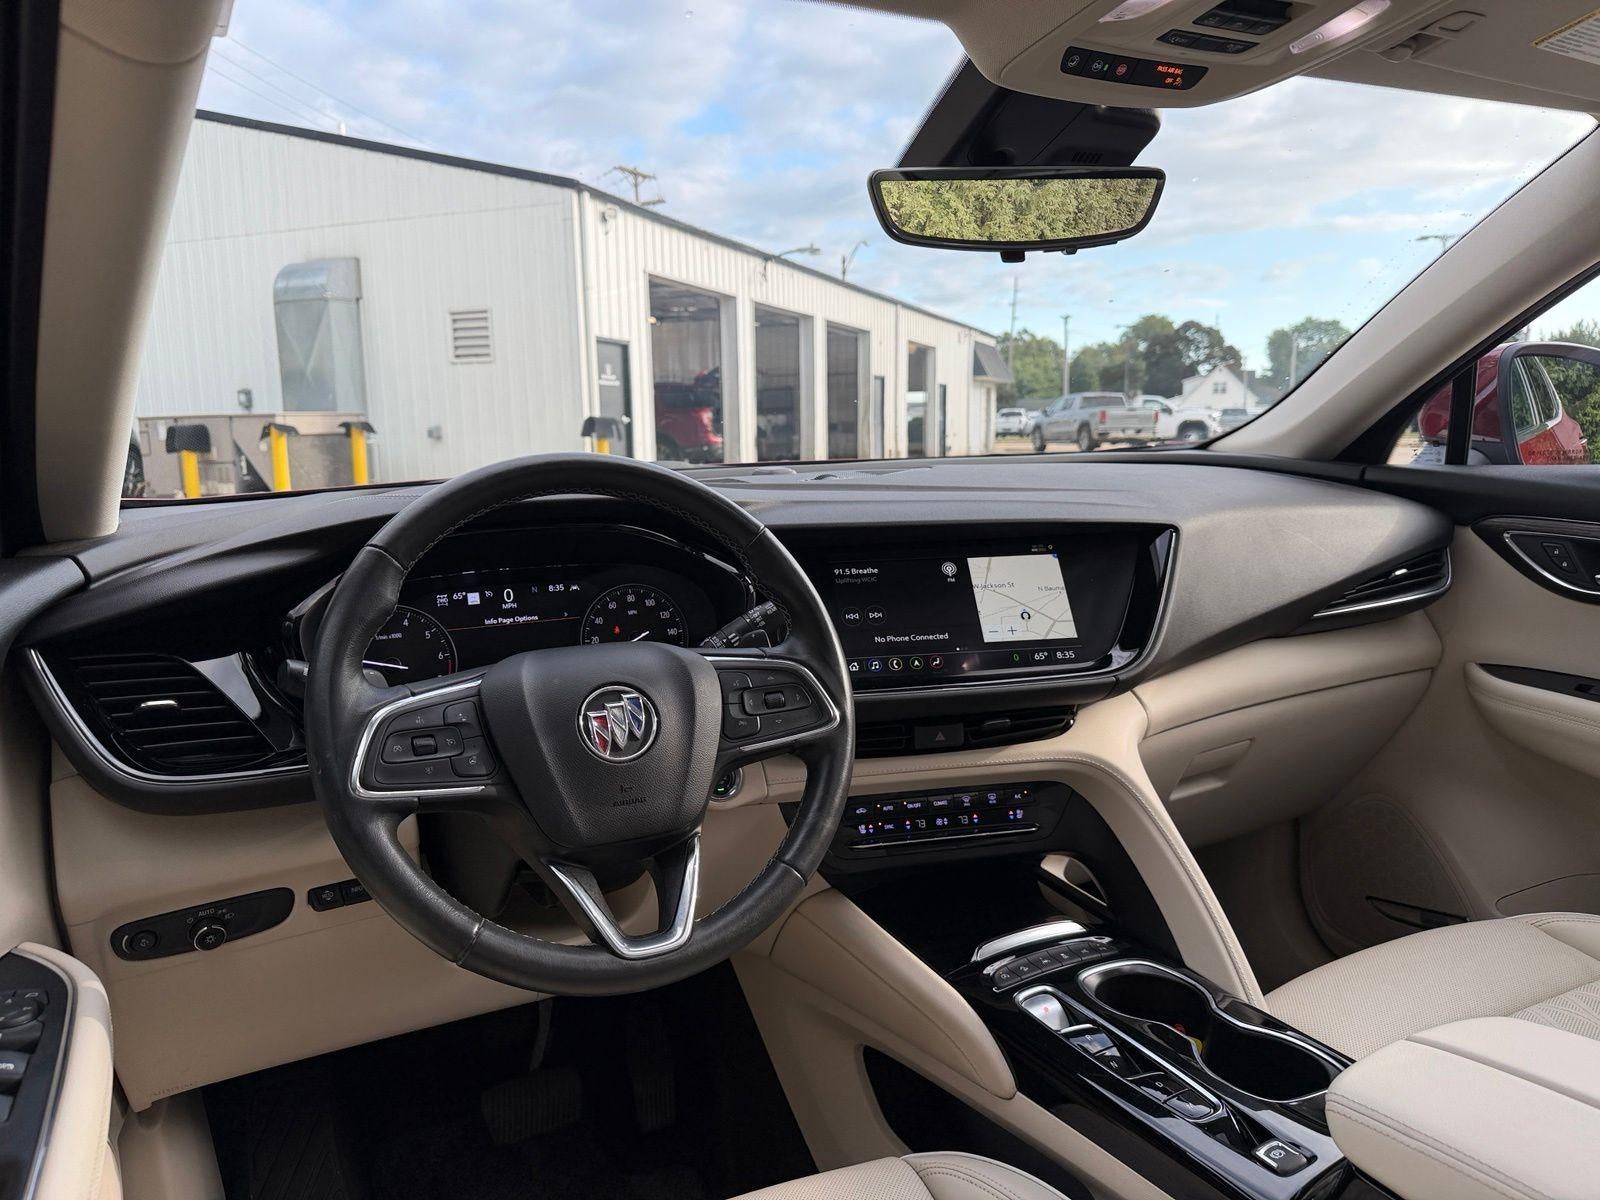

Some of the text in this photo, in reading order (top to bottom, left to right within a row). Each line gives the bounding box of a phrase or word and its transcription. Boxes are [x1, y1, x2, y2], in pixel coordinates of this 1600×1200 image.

[549, 584, 564, 592] 8:35
[980, 582, 1006, 590] Jackson
[504, 588, 514, 602] 0
[626, 594, 635, 602] 80
[660, 611, 670, 619] 120
[498, 616, 513, 625] Page
[515, 615, 538, 623] Options
[425, 631, 431, 639] 5
[910, 632, 948, 640] Connected
[1034, 652, 1048, 660] 65°
[1056, 651, 1075, 659] 8:35
[958, 815, 968, 824] 73
[916, 820, 926, 828] 73
[199, 908, 214, 916] AUTO
